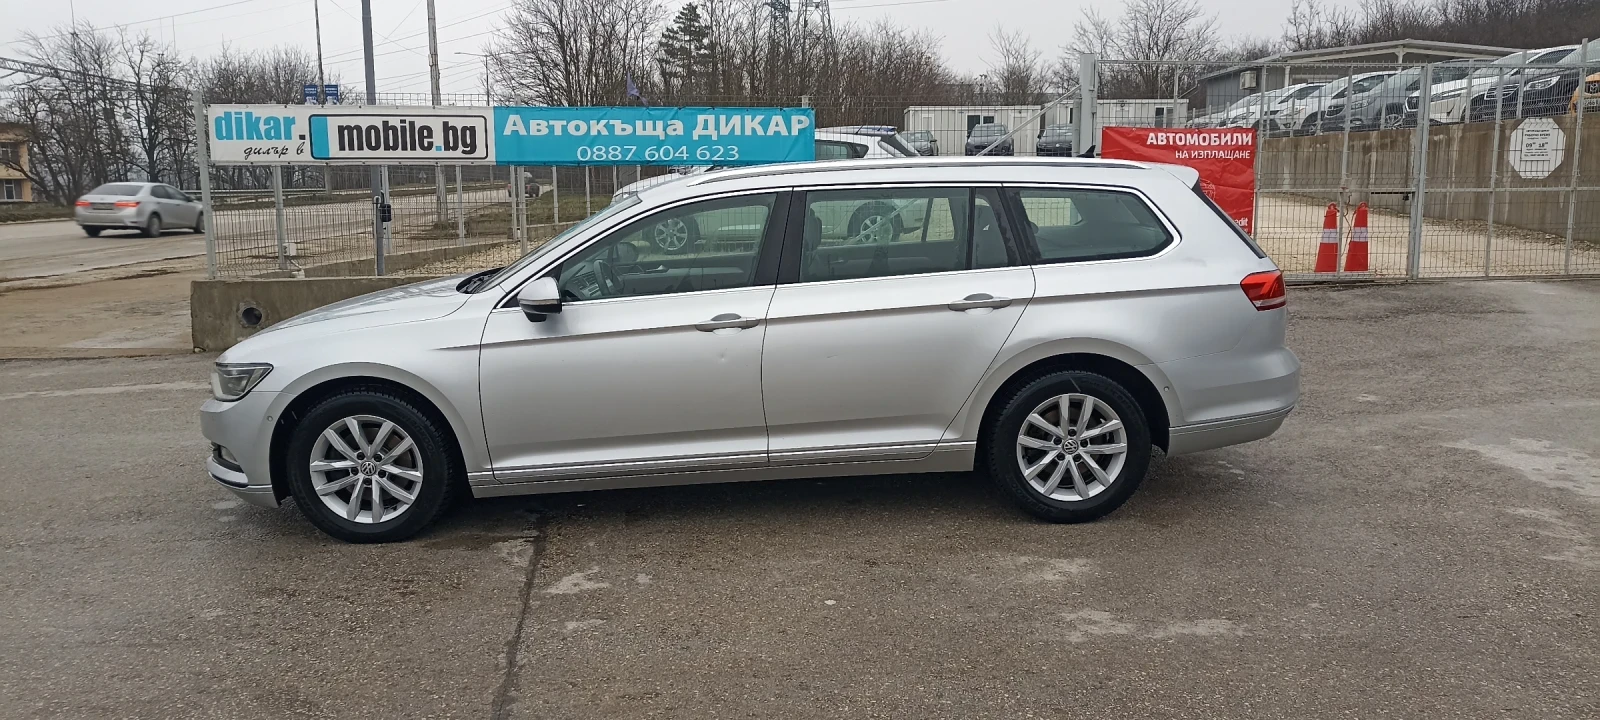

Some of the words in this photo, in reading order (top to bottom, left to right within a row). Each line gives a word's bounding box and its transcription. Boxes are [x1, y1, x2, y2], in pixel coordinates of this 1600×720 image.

[503, 114, 684, 140] Автокъща
[692, 114, 810, 140] ДИКАР
[338, 119, 477, 155] mobile.bg
[1146, 132, 1252, 146] АВТОМОБИЛИ
[577, 145, 637, 161] 0887
[644, 145, 690, 161] 604
[696, 145, 740, 161] 623
[1175, 150, 1189, 159] НА
[1191, 150, 1251, 160] ИЗПЛАЩАНЕ
